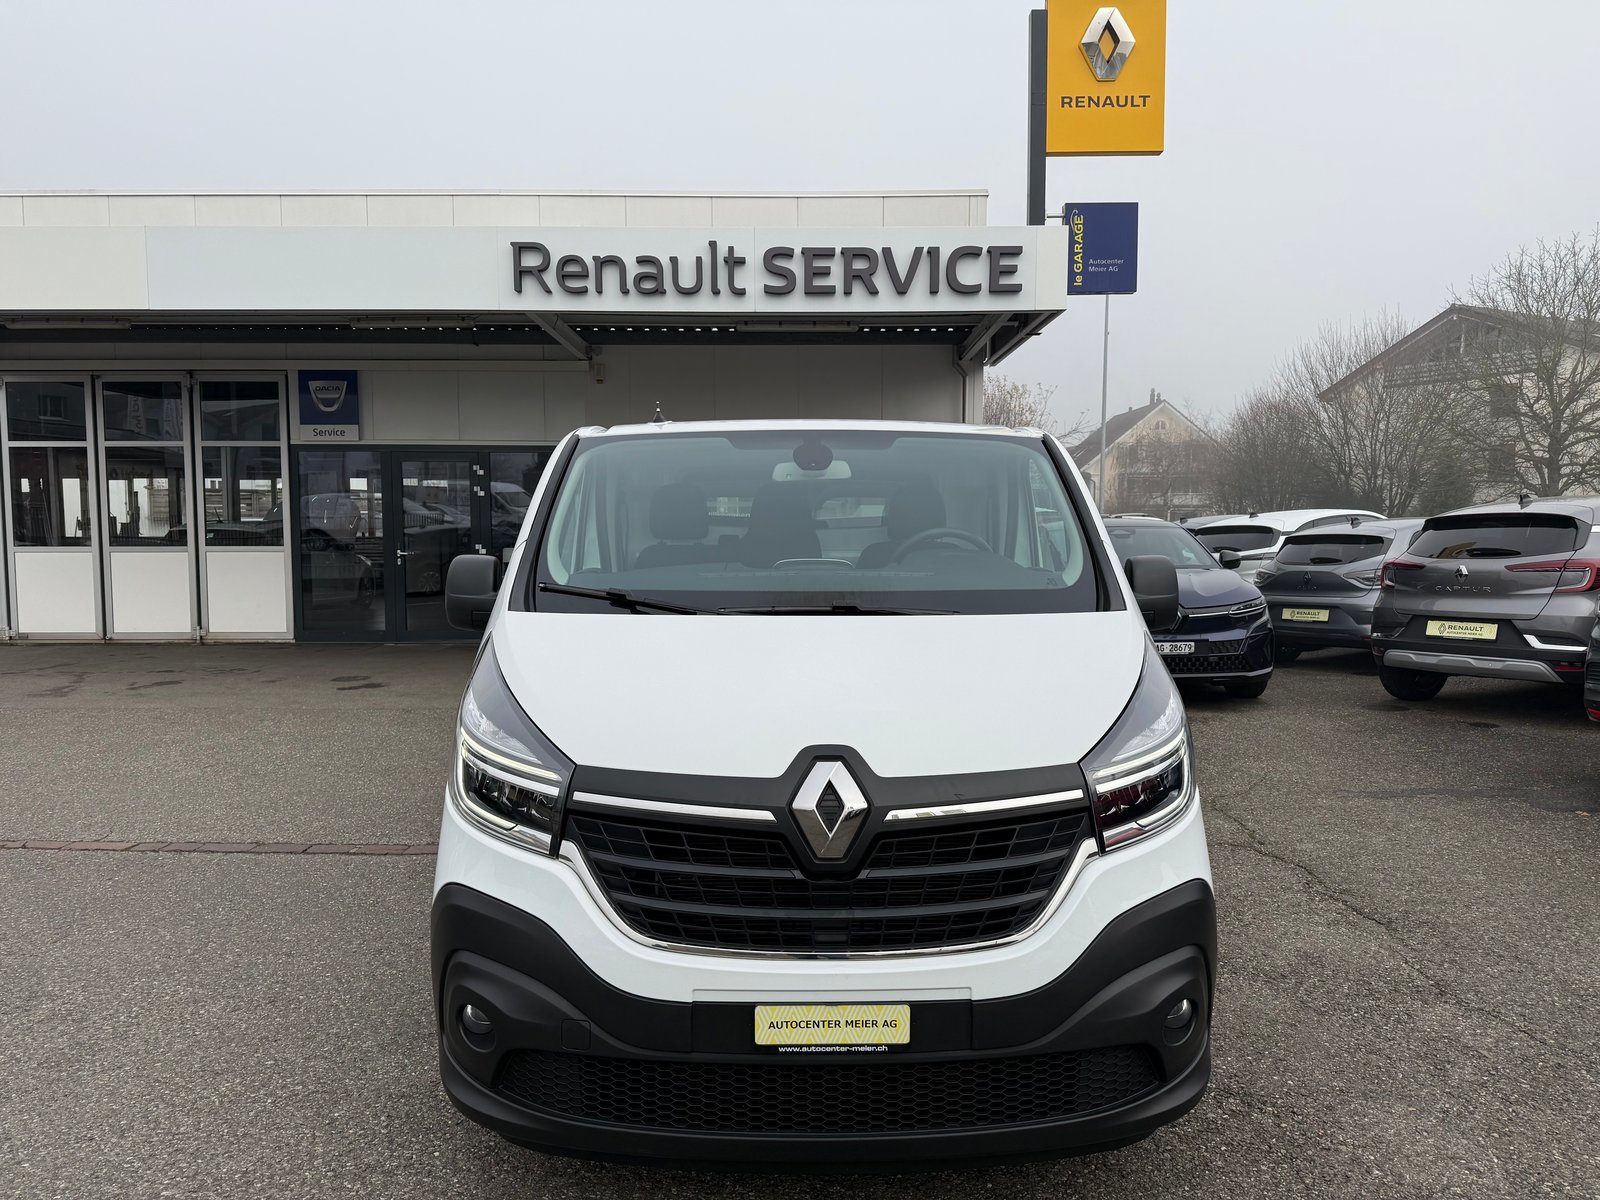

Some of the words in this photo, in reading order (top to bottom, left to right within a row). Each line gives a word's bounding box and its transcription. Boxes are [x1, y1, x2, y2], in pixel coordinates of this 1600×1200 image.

[1061, 95, 1151, 108] RENAULT
[1074, 214, 1084, 273] GARAGE
[510, 240, 747, 295] Renault
[763, 245, 1024, 296] SERVICE
[1073, 275, 1083, 286] le
[312, 428, 346, 437] Service
[1447, 624, 1484, 632] RENAULT
[768, 1019, 842, 1030] AUTOCENTER
[845, 1019, 879, 1029] MEIER
[882, 1019, 898, 1029] AG
